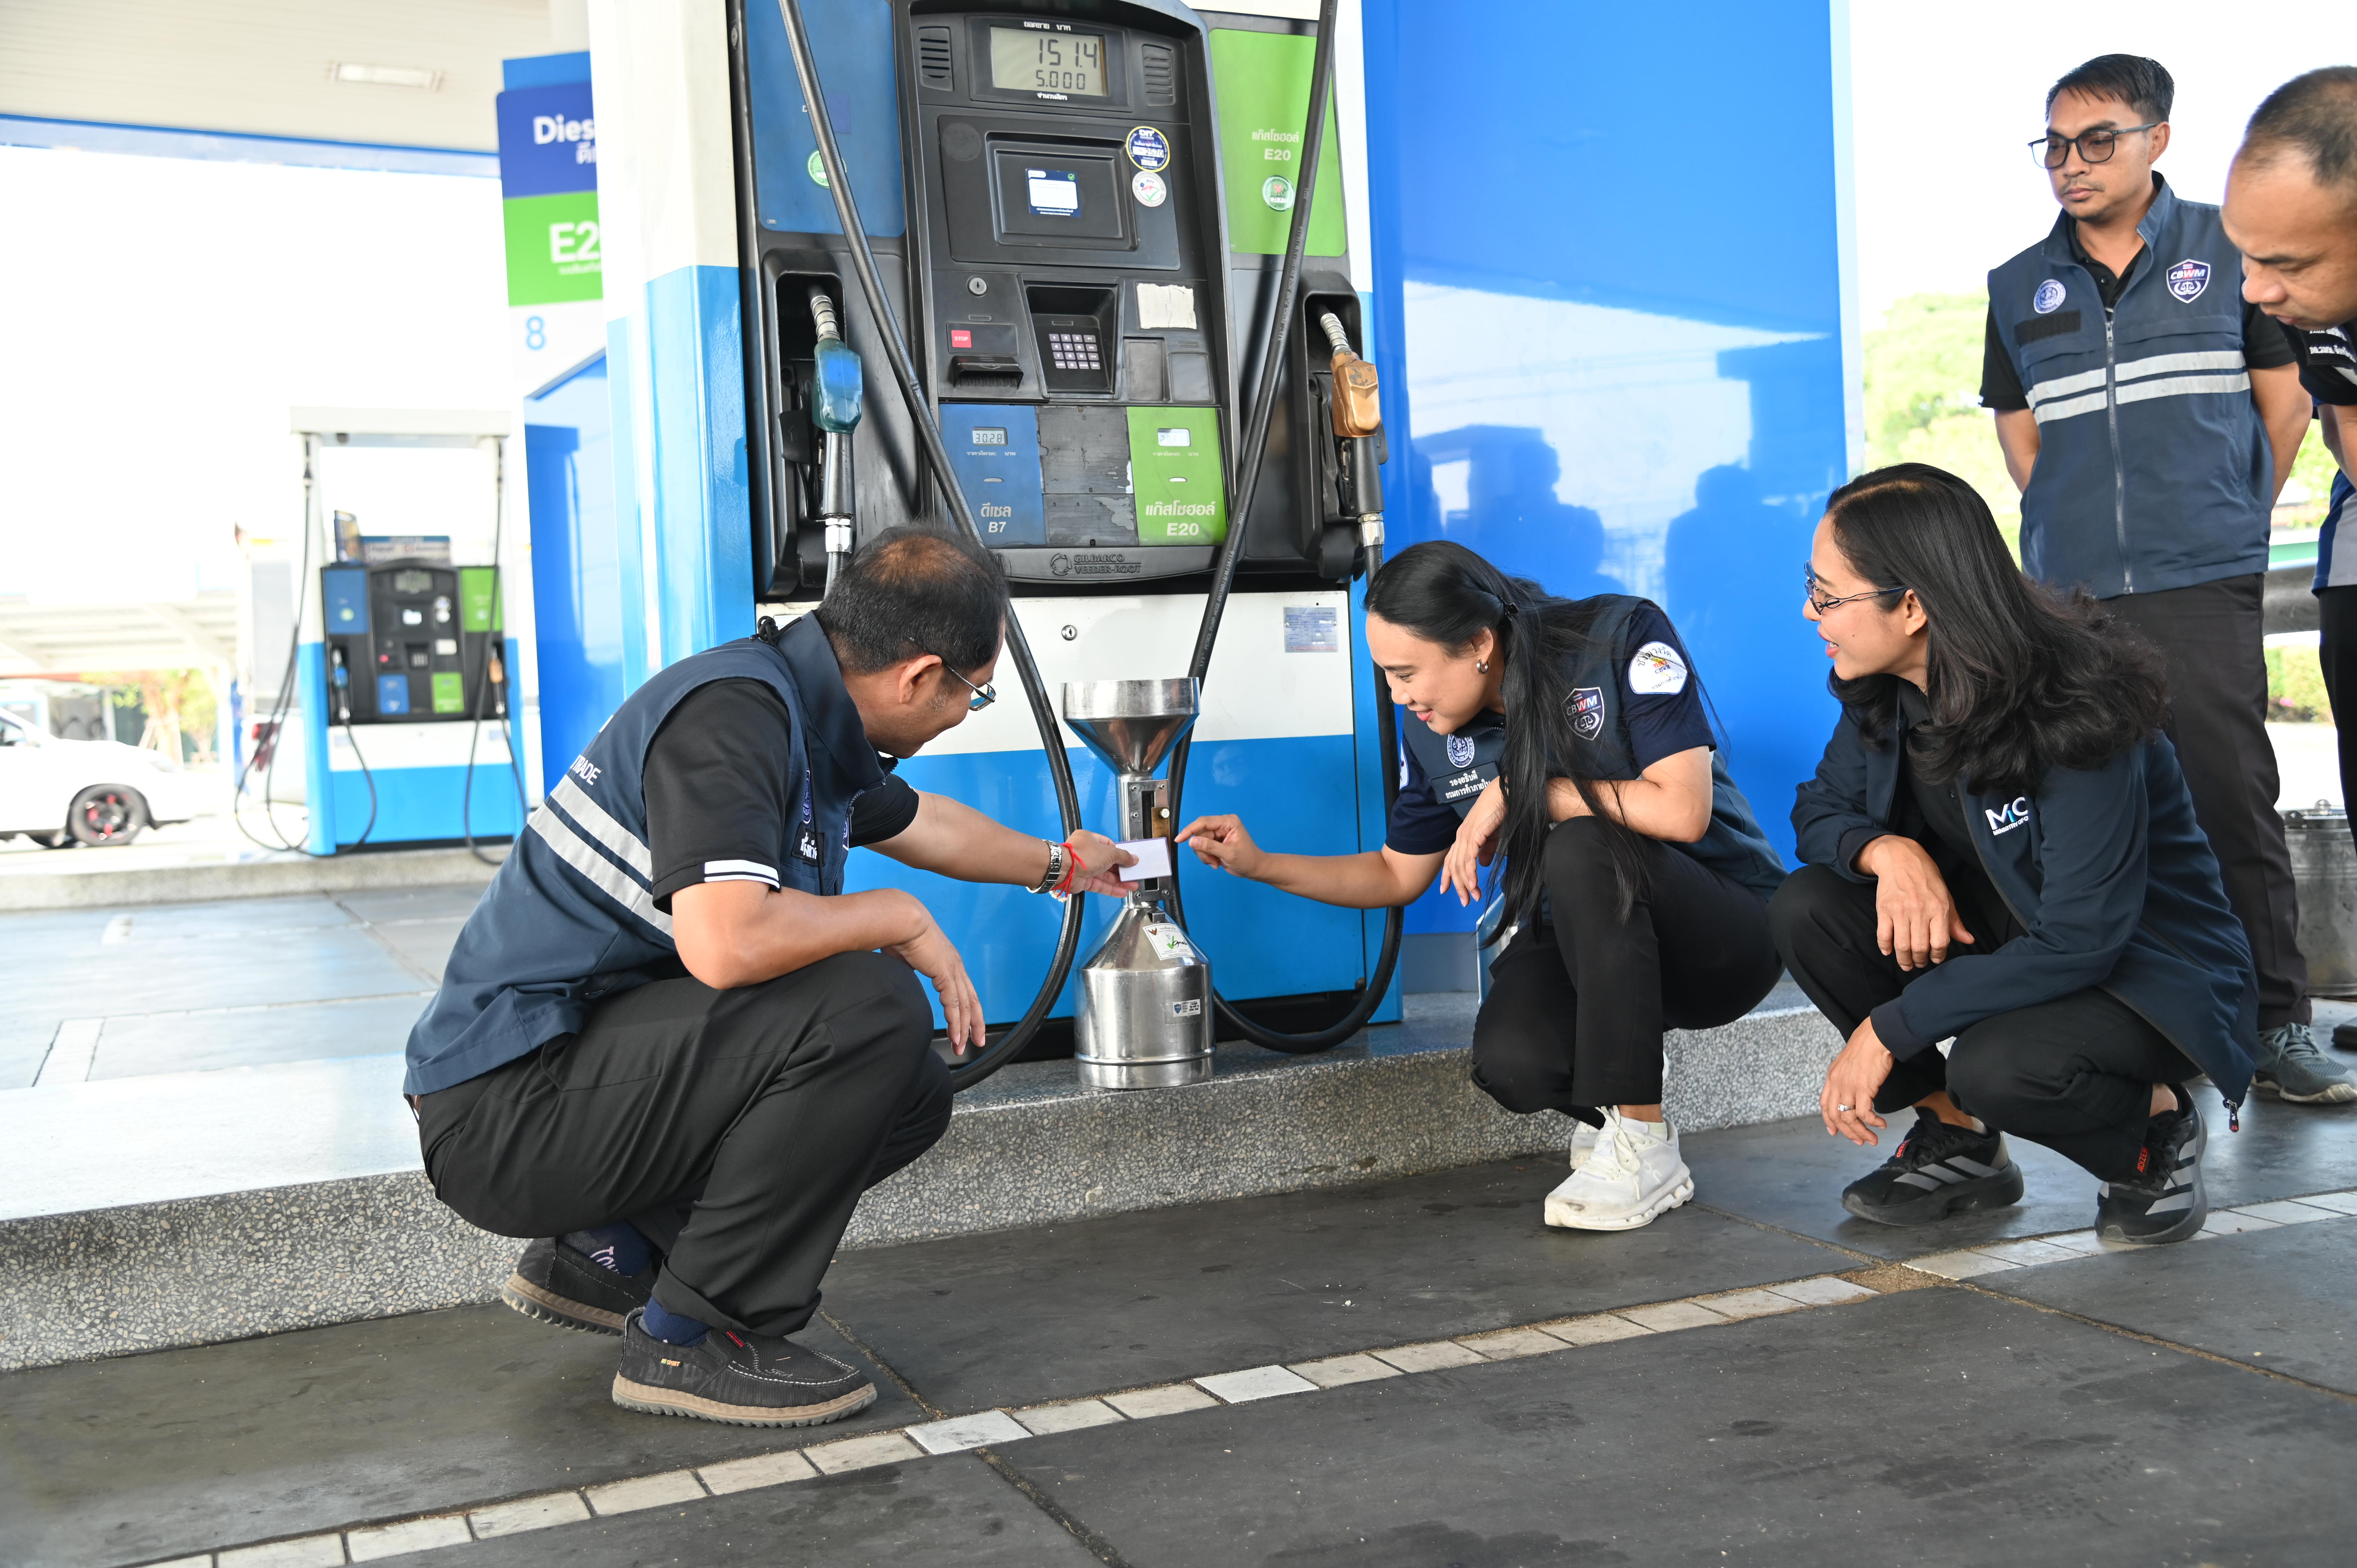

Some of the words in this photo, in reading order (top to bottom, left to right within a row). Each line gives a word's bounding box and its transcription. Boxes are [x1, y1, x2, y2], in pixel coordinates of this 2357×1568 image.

[1036, 70, 1085, 90] 5.000
[533, 113, 595, 145] Dies
[1252, 129, 1300, 143] แก๊สโซฮอล์
[1145, 149, 1163, 157] 2570
[1264, 148, 1291, 161] E20
[549, 220, 599, 264] E2
[2170, 269, 2205, 280] CBWM
[526, 316, 545, 350] 8
[975, 433, 1002, 443] 30.28
[981, 502, 1012, 517] ดีเซล
[1145, 500, 1216, 516] แก๊สโซฮอล์
[988, 521, 1006, 533] B7
[1167, 522, 1199, 536] E20
[1074, 554, 1125, 563] GILBARCO
[1074, 565, 1141, 574] VEEDER-ROOT
[1204, 633, 1212, 650] PETROL
[1655, 664, 1671, 673] CBWM
[1567, 694, 1597, 715] CBWM
[1449, 770, 1478, 786] รองอธิบดี
[1993, 821, 2018, 835] MINISTRY
[2137, 1147, 2148, 1172] ADIZER
